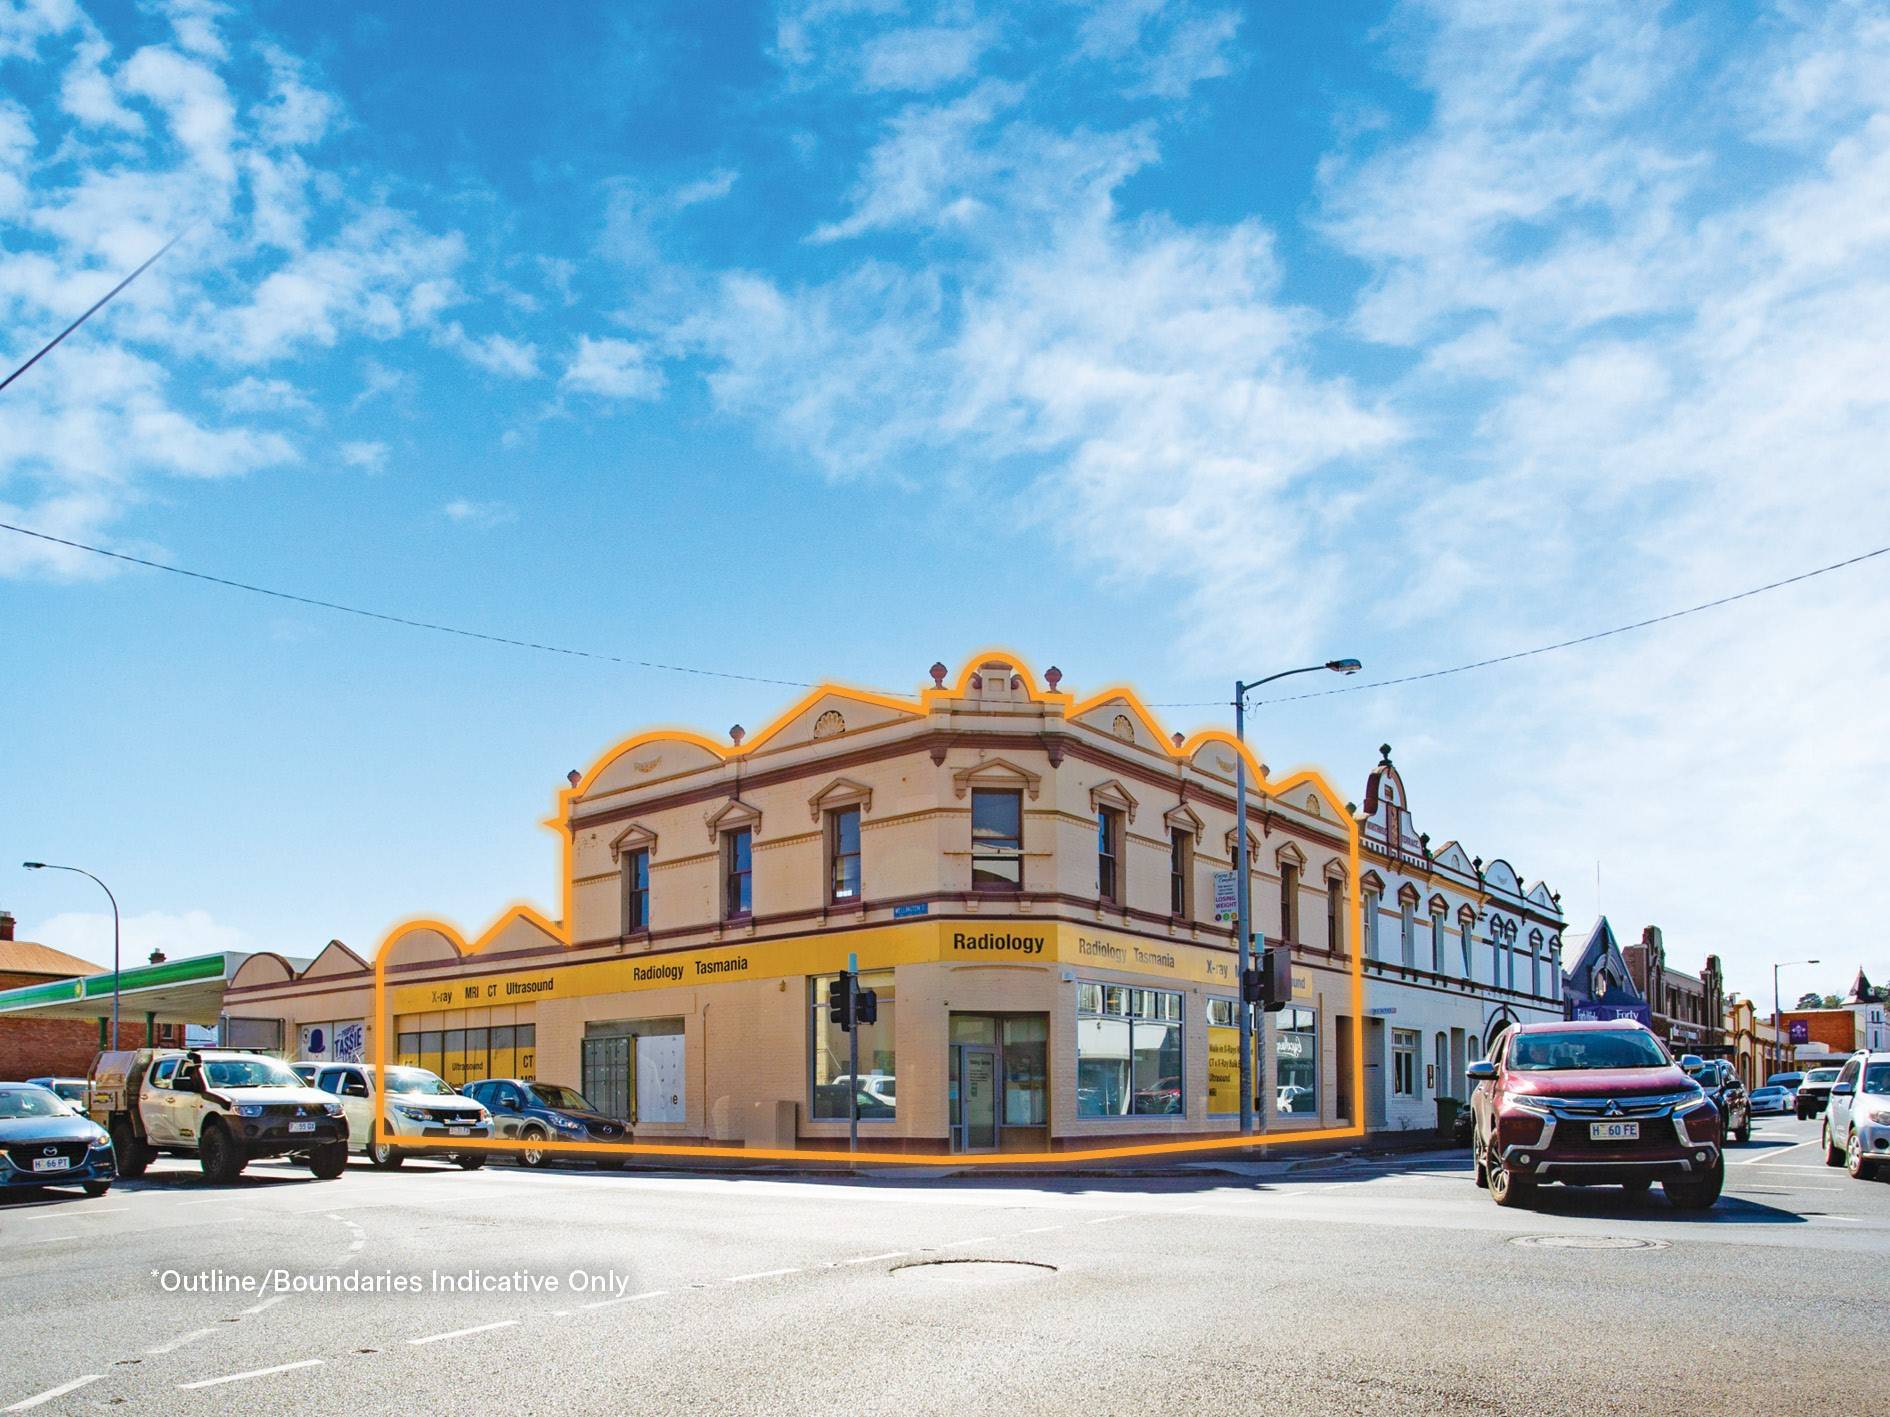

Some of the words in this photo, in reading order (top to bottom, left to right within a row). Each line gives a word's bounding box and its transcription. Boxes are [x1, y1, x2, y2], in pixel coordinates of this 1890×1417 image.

[953, 933, 1044, 953] Radiology
[1079, 937, 1127, 963] Radiology
[1133, 947, 1175, 968] Tasmania
[432, 991, 453, 1004] X-ray
[465, 985, 479, 999] MRI
[488, 984, 497, 998] CT
[506, 977, 554, 995] Ultrasound
[633, 964, 684, 981] Radiology
[695, 956, 748, 974] Tasmania
[335, 1027, 362, 1057] TASSIE
[523, 1055, 534, 1068] CT
